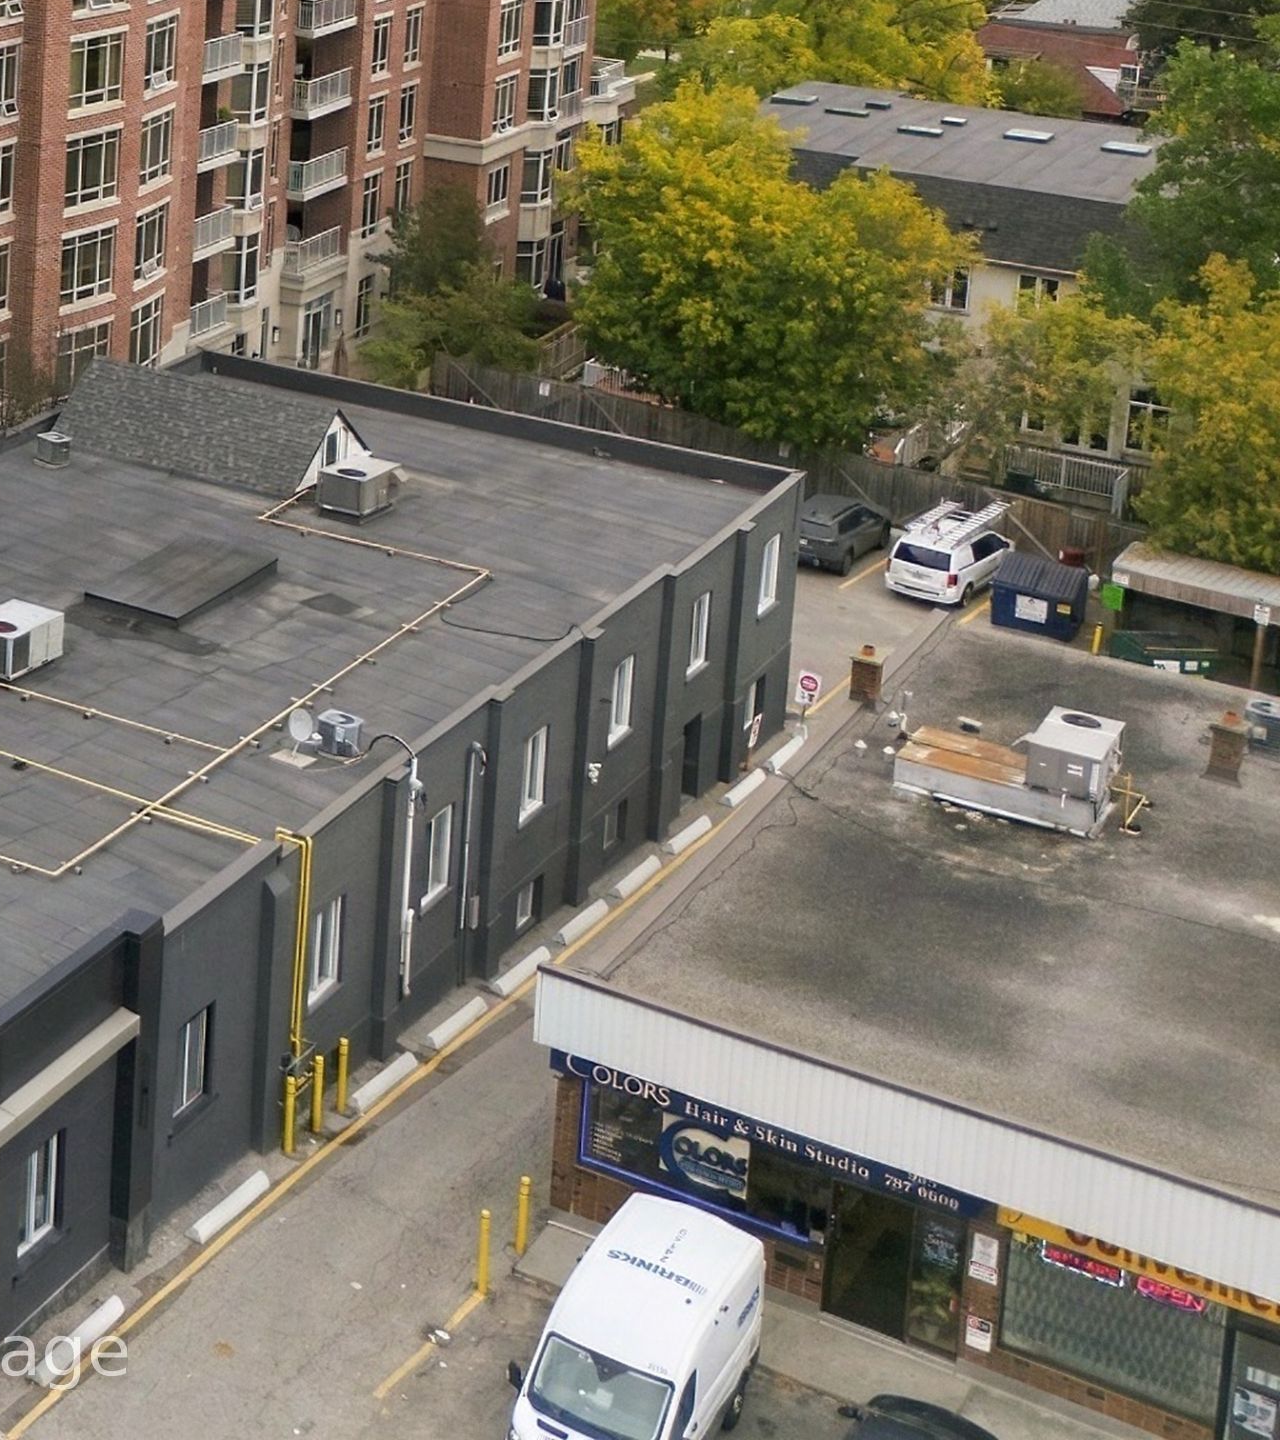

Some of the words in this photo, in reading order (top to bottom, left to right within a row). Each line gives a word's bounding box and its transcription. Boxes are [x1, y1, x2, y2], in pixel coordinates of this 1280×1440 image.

[566, 1054, 671, 1106] COLORS
[684, 1100, 729, 1128] Hair
[733, 1118, 750, 1135] &
[754, 1125, 798, 1153] Skin
[803, 1143, 870, 1179] Studio
[883, 1172, 913, 1194] 787
[917, 1185, 960, 1212] 0600
[606, 1249, 692, 1289] BRINKS
[1137, 1274, 1206, 1312] OPEN
